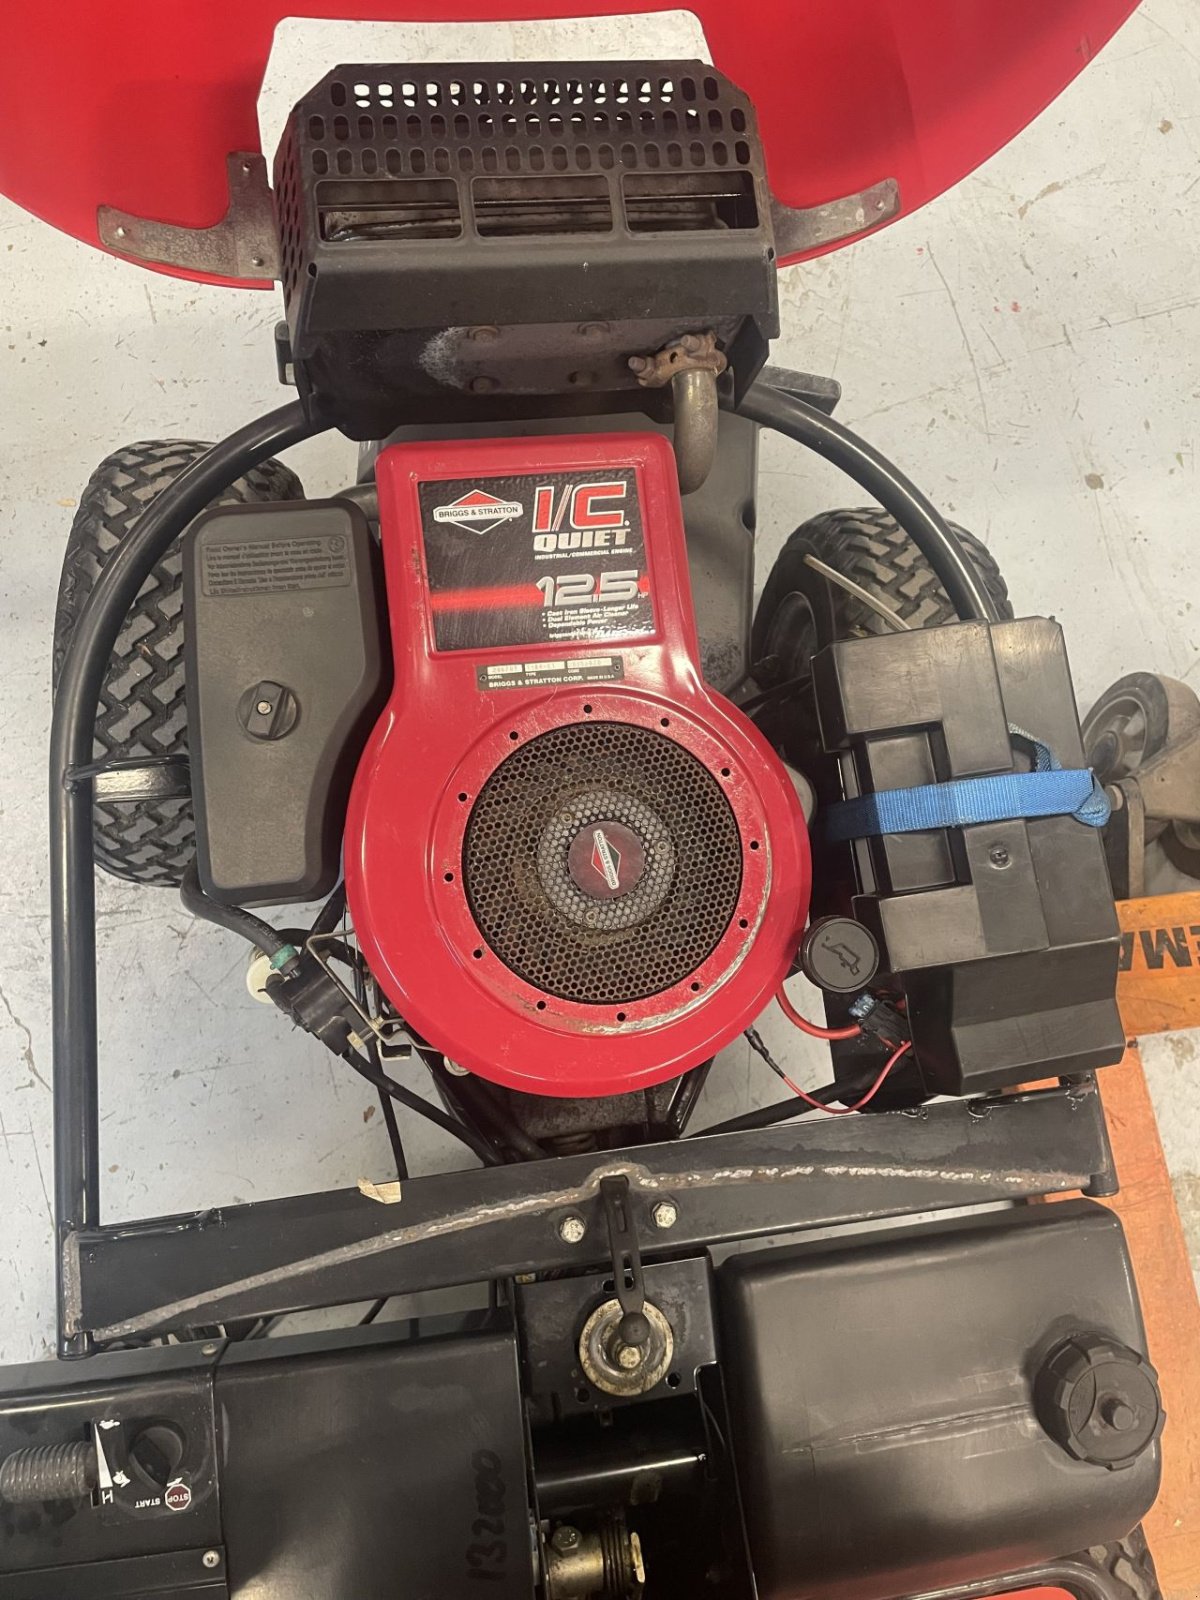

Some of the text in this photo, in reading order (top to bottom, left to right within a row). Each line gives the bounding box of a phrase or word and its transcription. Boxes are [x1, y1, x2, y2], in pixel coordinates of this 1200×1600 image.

[438, 510, 470, 518] BRIGGS
[478, 506, 519, 516] STRATTON
[533, 528, 631, 552] QUIET
[534, 547, 633, 560] INDUSTRIAL/COMMERCIAL ENGINE
[536, 570, 638, 607] 12.5
[627, 603, 639, 611] Life
[489, 680, 516, 688] BRIGGS
[525, 677, 562, 685] STRATTON
[135, 1497, 160, 1508] START
[168, 1493, 189, 1503] STOP
